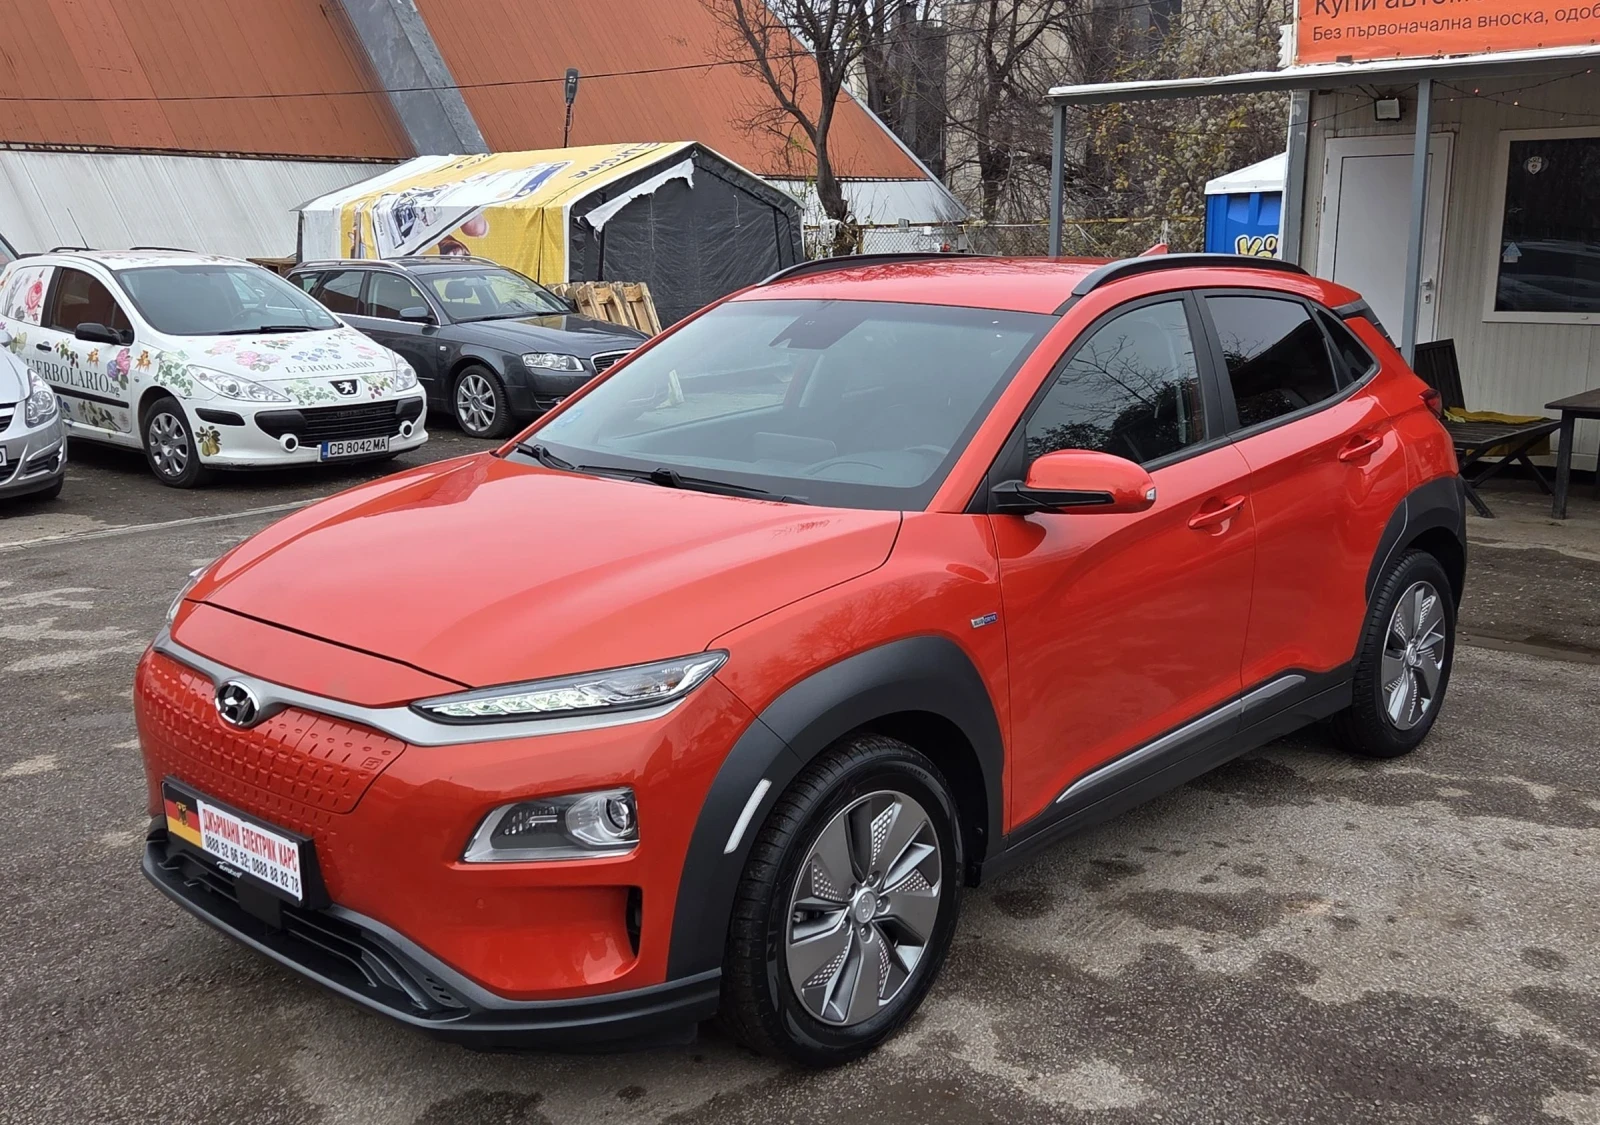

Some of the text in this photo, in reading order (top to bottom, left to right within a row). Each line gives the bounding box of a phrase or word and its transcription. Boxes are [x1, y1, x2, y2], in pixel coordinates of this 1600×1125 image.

[1313, 26, 1341, 41] Без
[1346, 17, 1472, 39] първоначална
[1477, 10, 1549, 28] вноска,
[329, 438, 386, 455] CB 8042 MA
[205, 834, 220, 854] 0888
[221, 842, 229, 859] 52
[252, 857, 268, 878] 0888
[280, 870, 289, 887] 82
[290, 875, 299, 893] 78
[278, 842, 297, 872] КАРС
